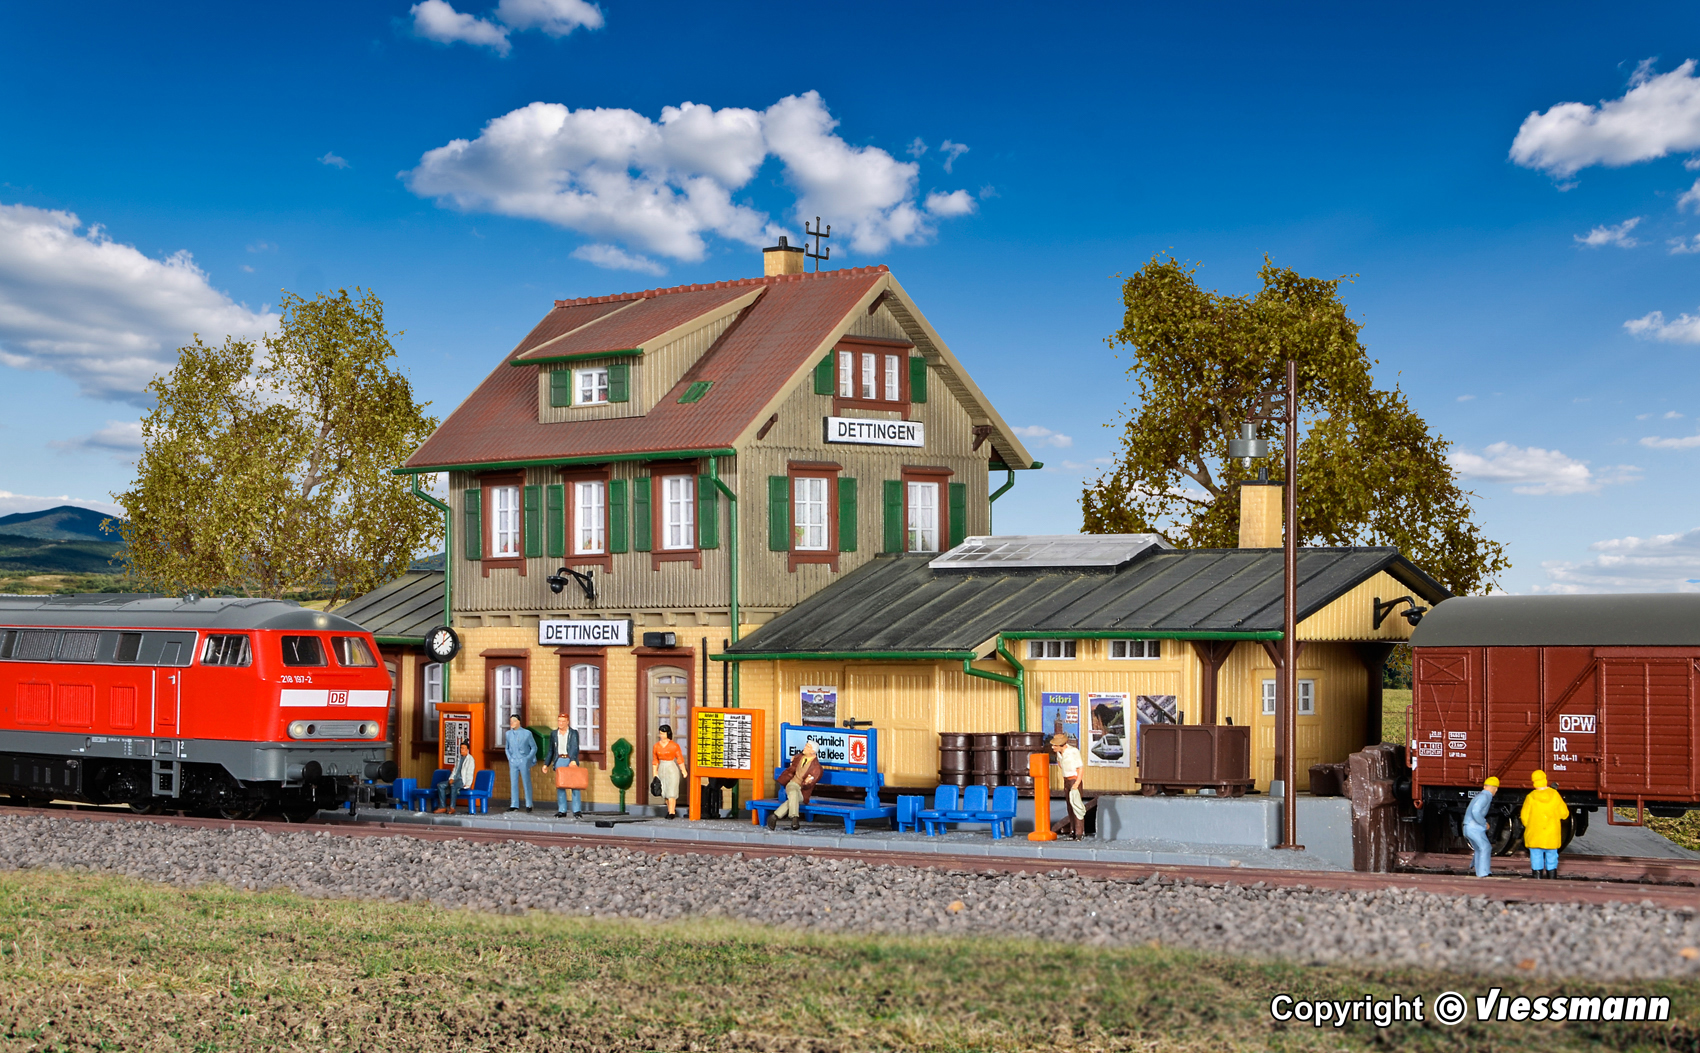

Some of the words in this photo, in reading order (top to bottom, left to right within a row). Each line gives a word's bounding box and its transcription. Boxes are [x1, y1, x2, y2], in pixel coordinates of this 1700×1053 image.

[838, 421, 915, 441] DETTINGEN
[546, 625, 619, 640] DETTINGEN
[331, 693, 345, 704] DB
[1049, 695, 1072, 704] kibri
[1562, 716, 1593, 731] OPW
[807, 735, 845, 747] Südmilch
[1553, 737, 1567, 752] DR
[827, 749, 845, 760] Idee
